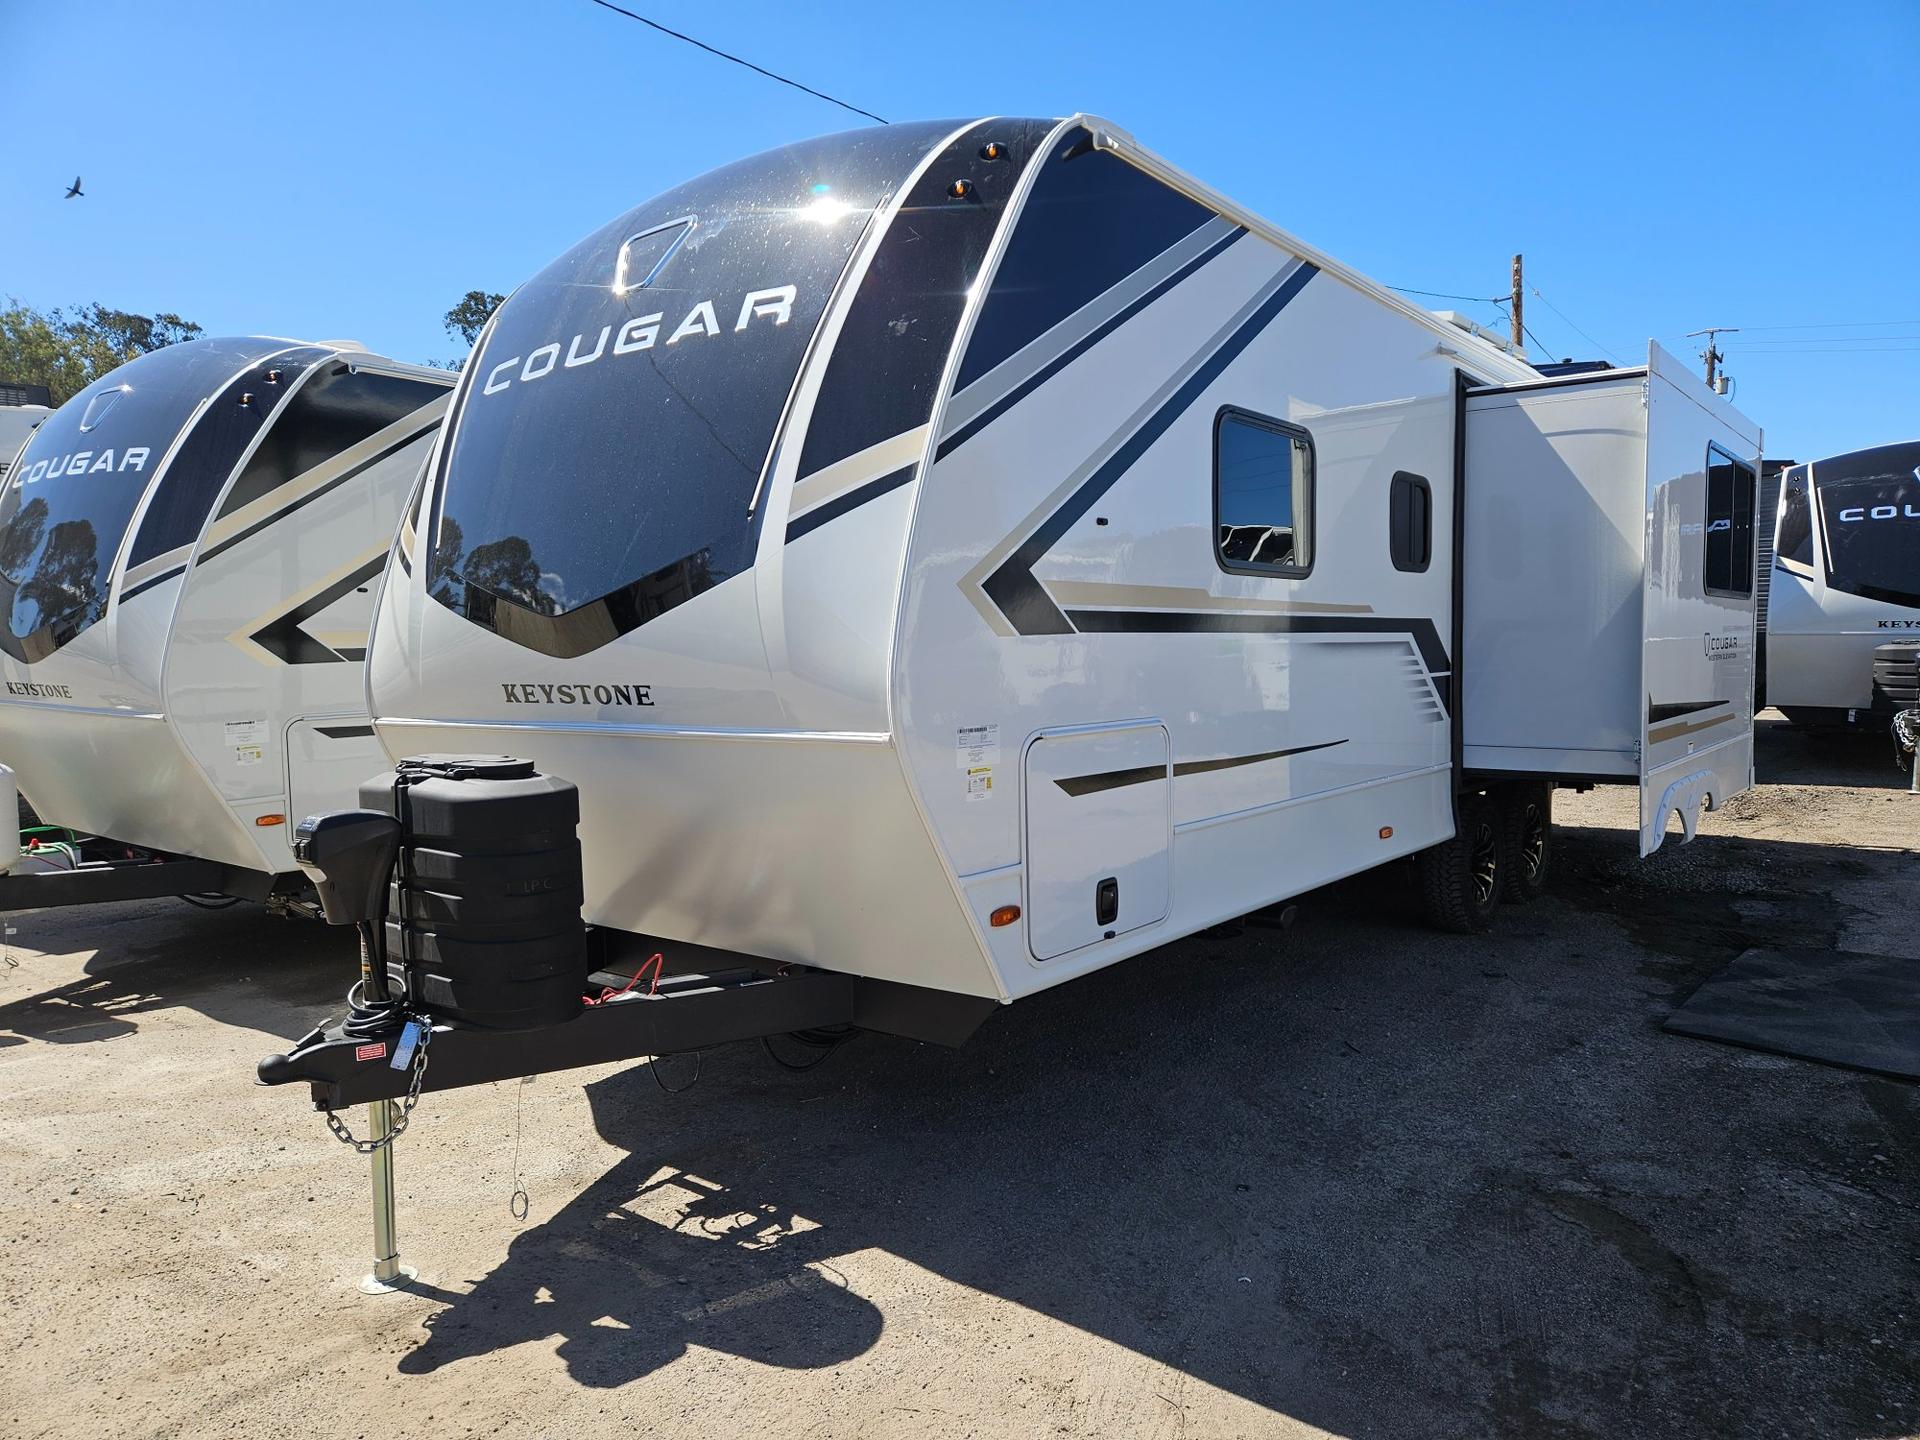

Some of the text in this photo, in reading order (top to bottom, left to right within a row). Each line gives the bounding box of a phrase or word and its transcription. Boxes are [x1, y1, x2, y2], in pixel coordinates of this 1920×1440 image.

[483, 284, 798, 395] COUGAR
[12, 446, 151, 489] COUGAR
[1711, 636, 1738, 650] COUGAR
[6, 681, 73, 699] KEYSTONE
[501, 683, 655, 706] KEYSTONE
